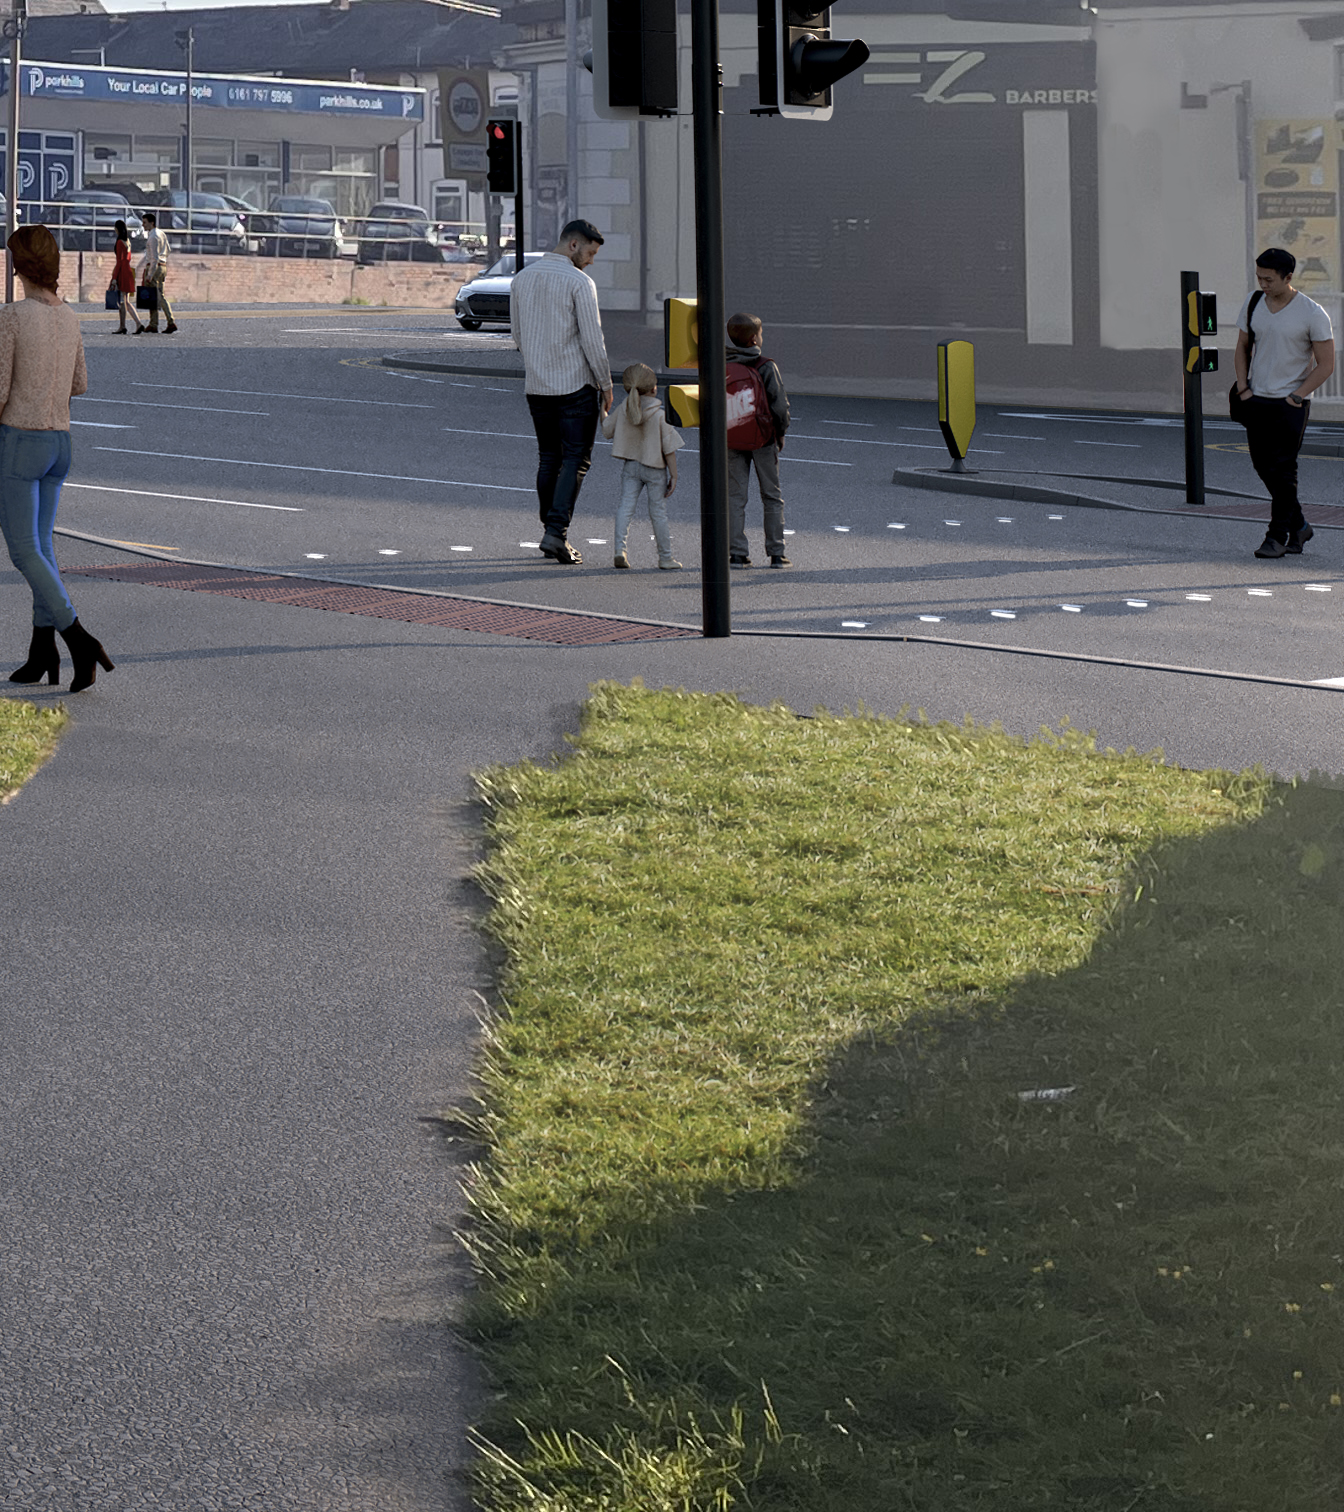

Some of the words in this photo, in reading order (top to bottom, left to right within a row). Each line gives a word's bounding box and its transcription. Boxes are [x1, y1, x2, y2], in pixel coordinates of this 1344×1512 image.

[107, 77, 131, 92] Your
[132, 80, 160, 94] Local
[161, 81, 178, 95] Car
[180, 83, 212, 99] Pople
[1006, 89, 1098, 104] BARBERS
[727, 387, 757, 422] IKE
